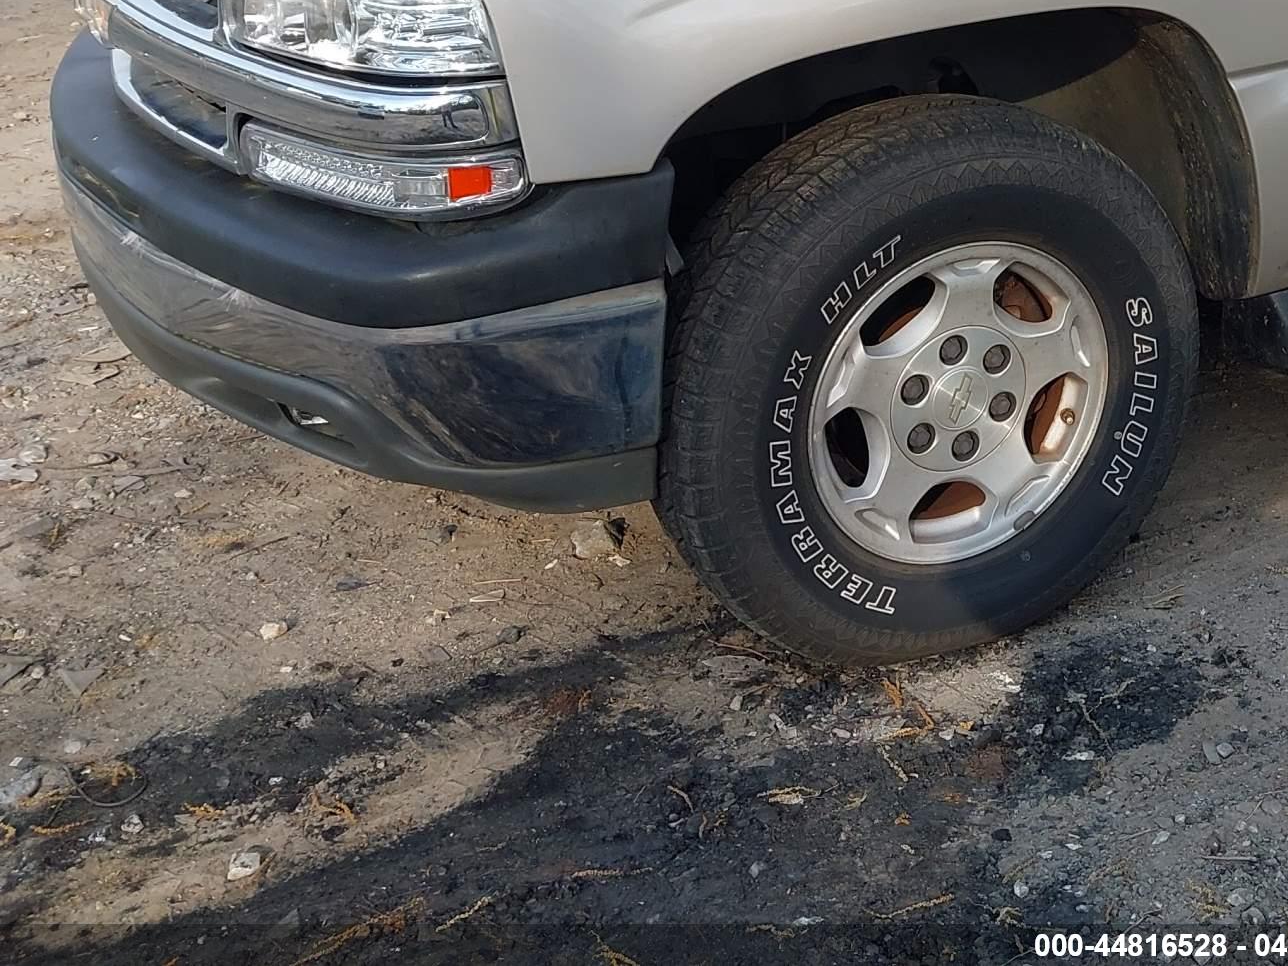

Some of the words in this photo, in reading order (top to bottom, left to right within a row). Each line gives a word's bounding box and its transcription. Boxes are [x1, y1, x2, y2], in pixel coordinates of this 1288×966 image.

[820, 235, 901, 325] HLT
[769, 350, 897, 615] TERRAMAX
[1101, 297, 1158, 496] SAILUN
